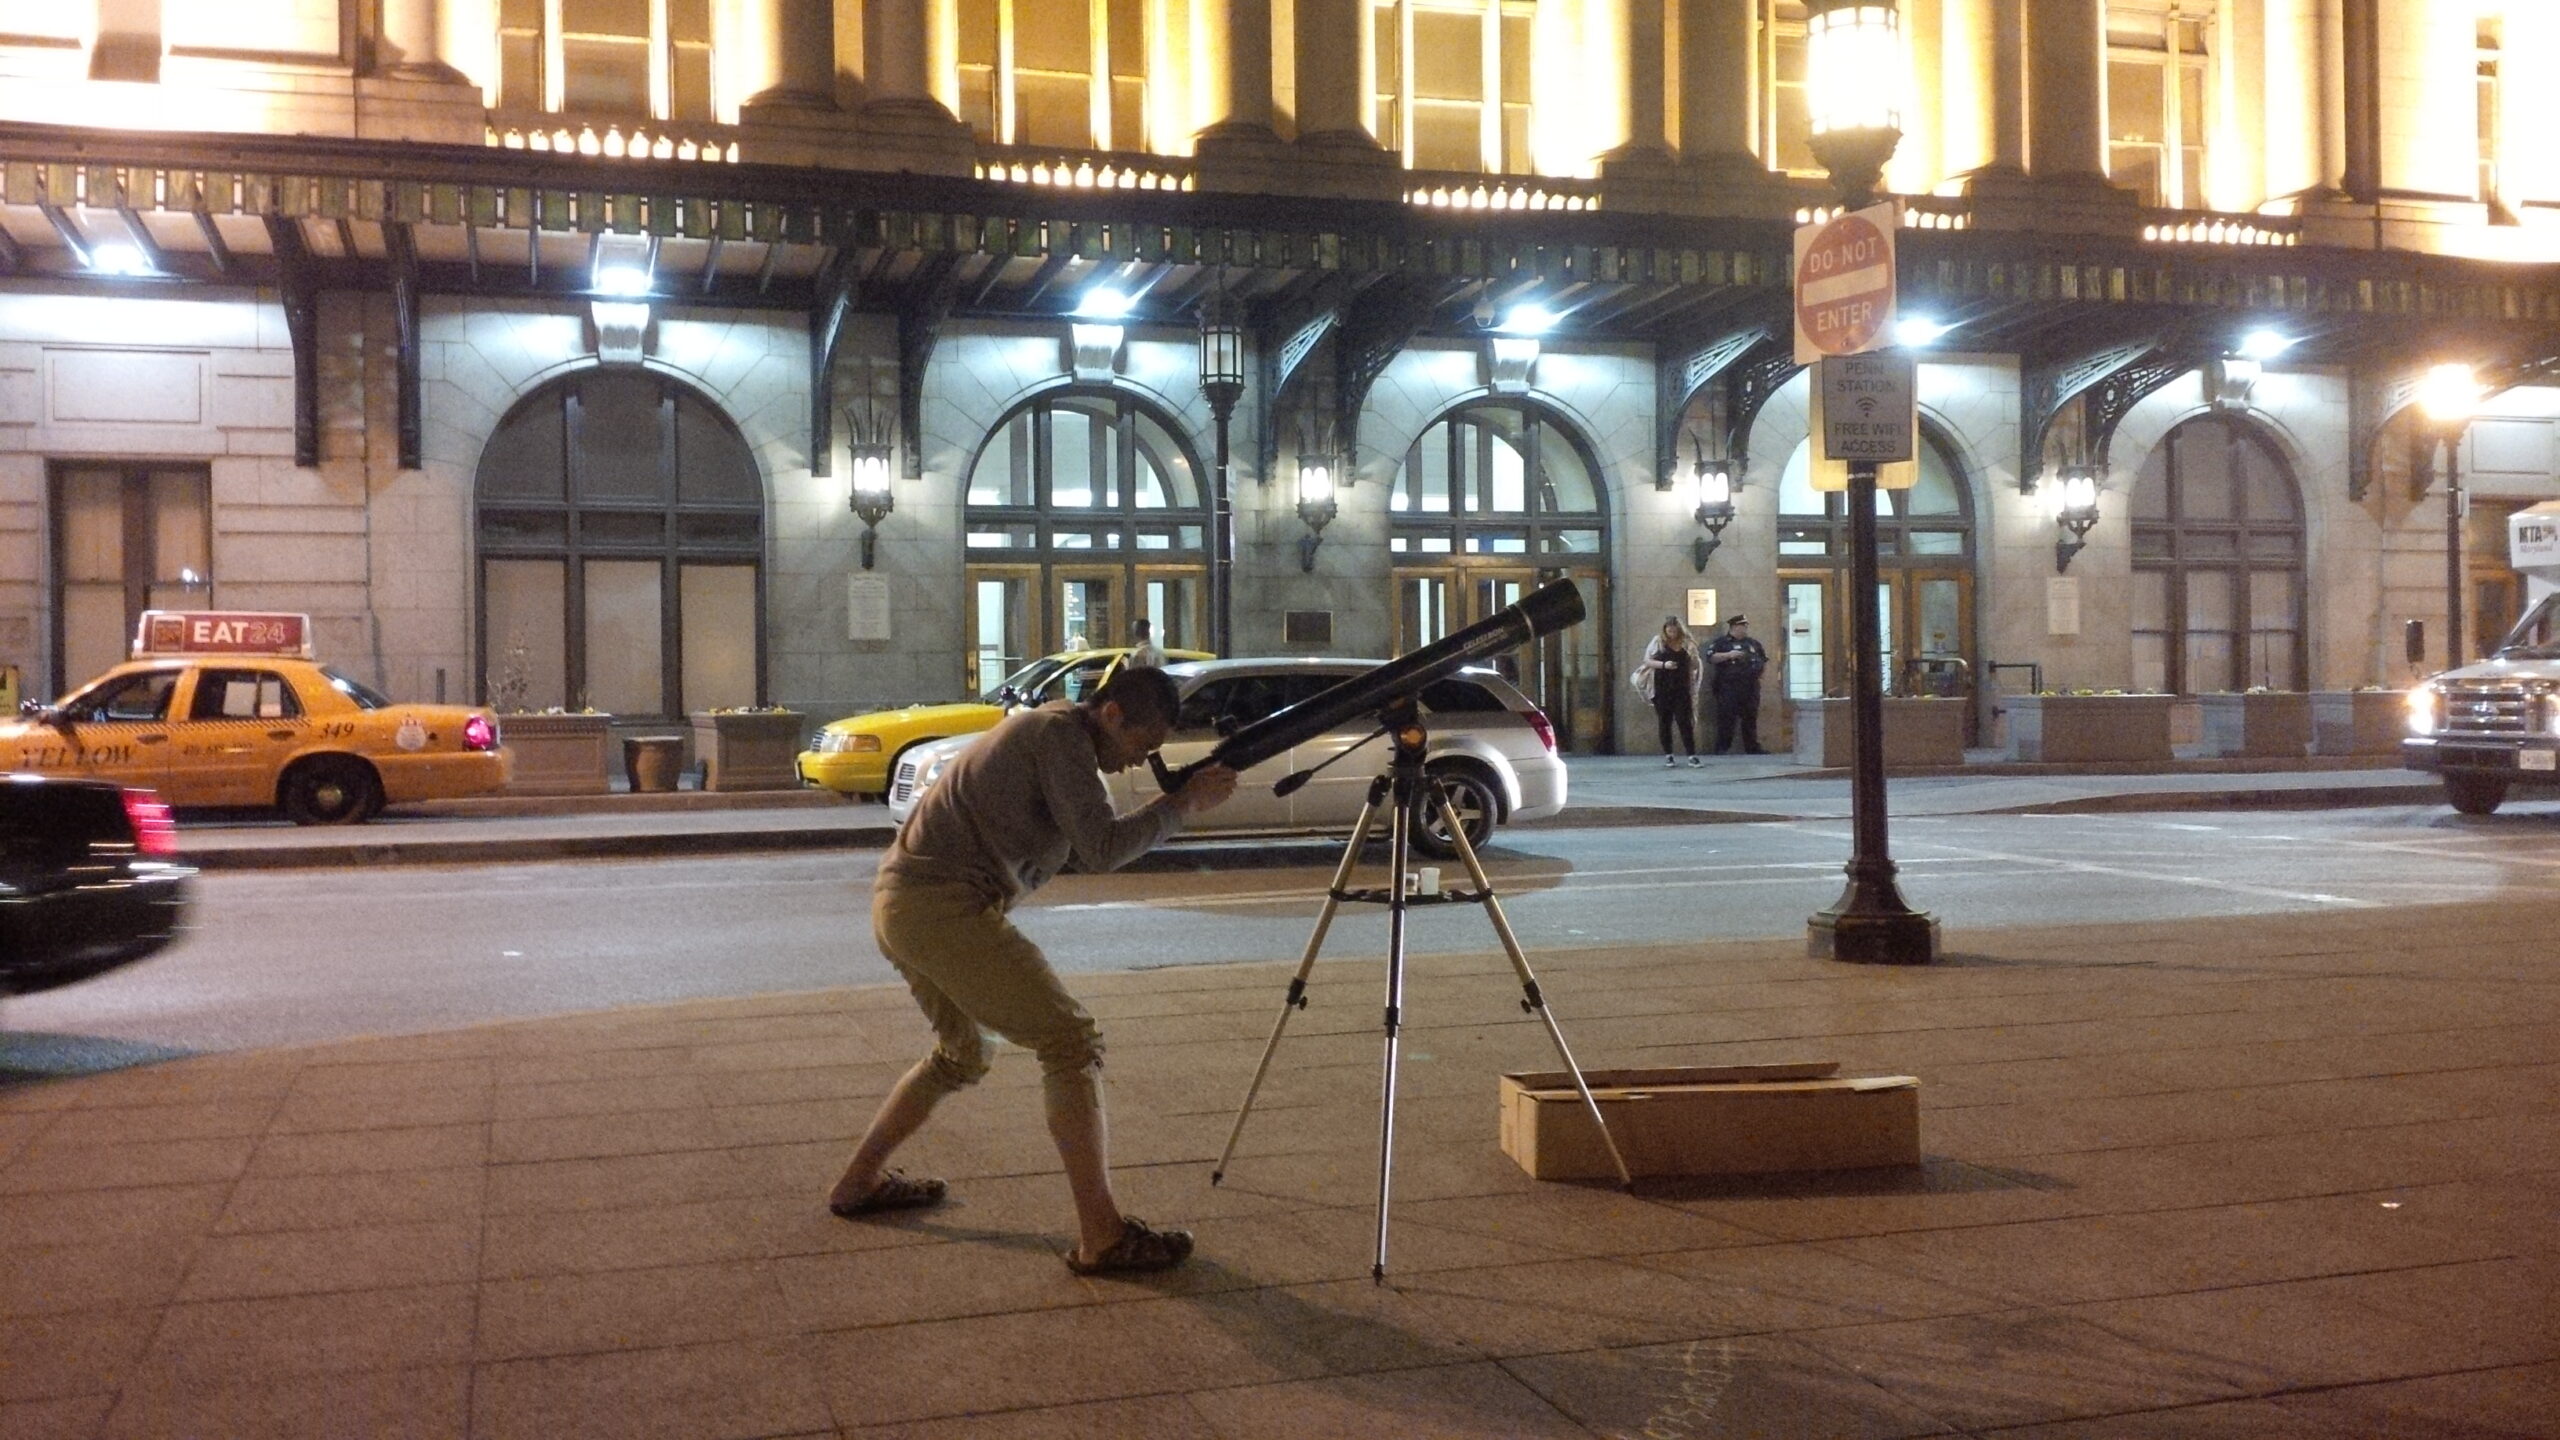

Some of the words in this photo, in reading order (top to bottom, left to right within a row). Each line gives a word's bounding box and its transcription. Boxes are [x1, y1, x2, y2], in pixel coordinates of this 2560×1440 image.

[1811, 252, 1833, 274] DO
[1842, 237, 1877, 265] NOT
[1816, 301, 1873, 332] ENTER
[1845, 361, 1884, 376] PENN
[1836, 379, 1896, 393] STATION
[1834, 422, 1869, 436] FREE
[1840, 439, 1897, 454] ACCESS
[2519, 526, 2543, 543] MTA
[319, 721, 355, 740] 349
[21, 744, 133, 767] YELLOW
